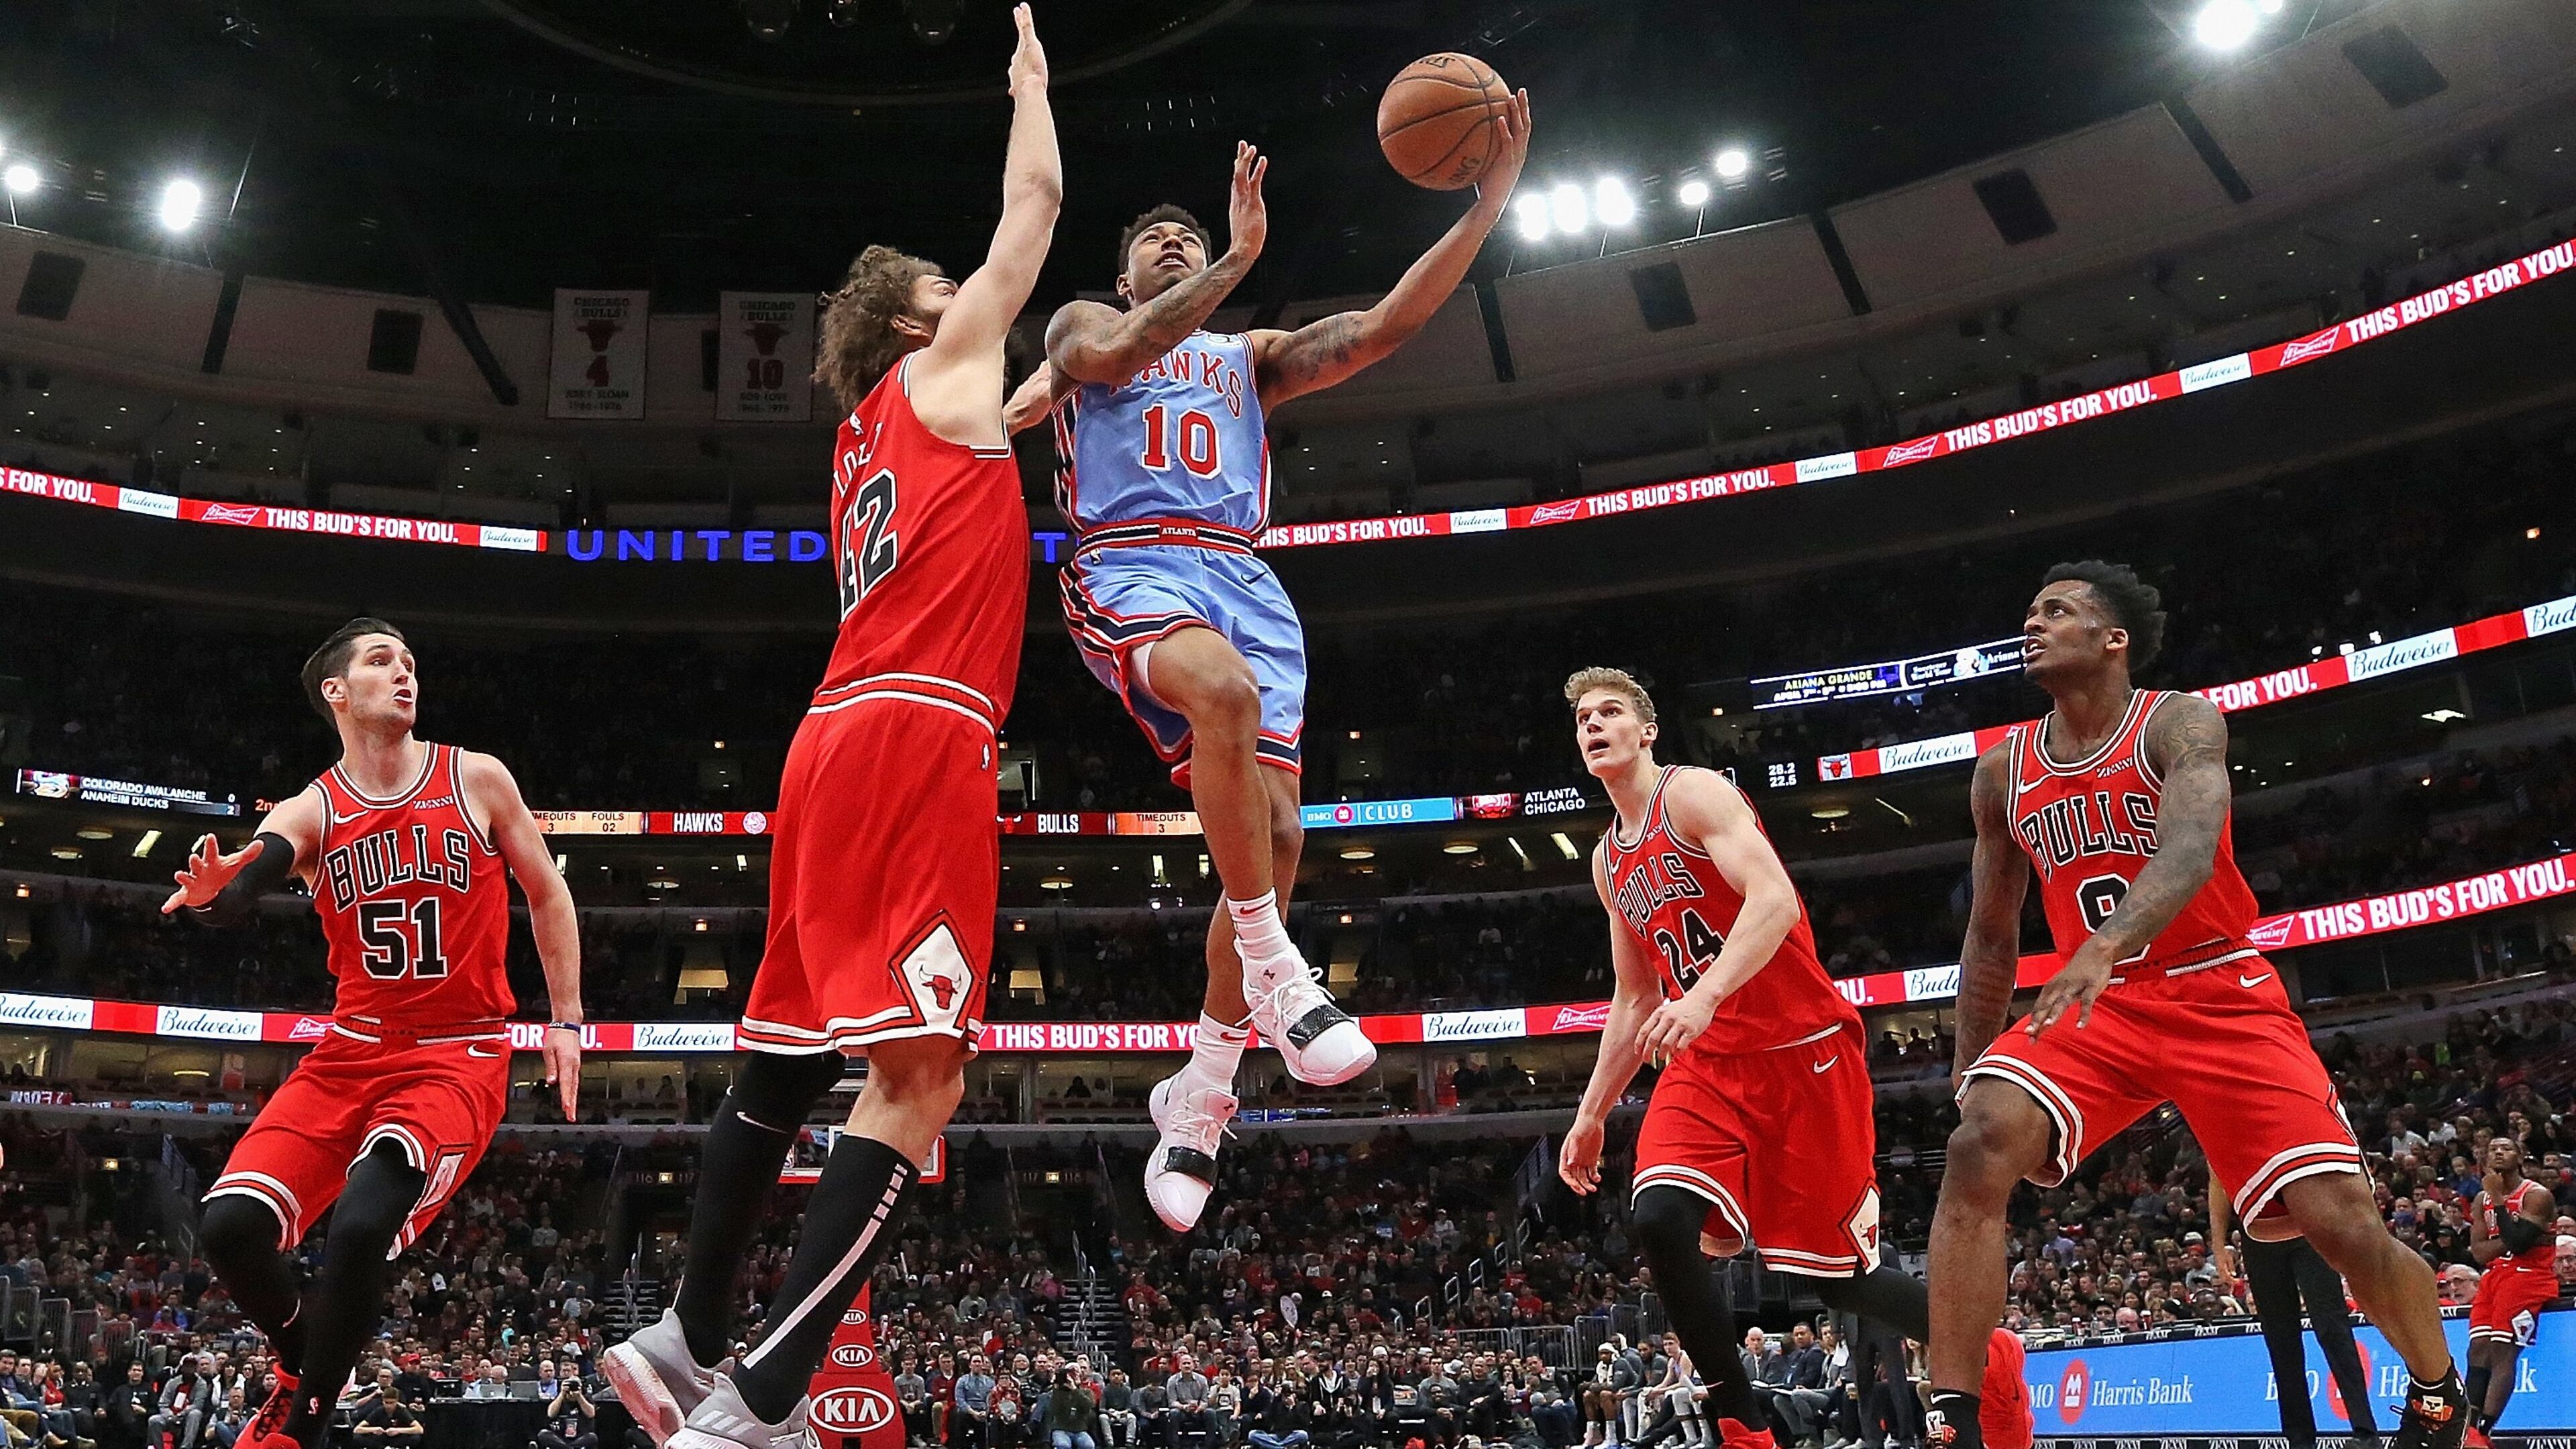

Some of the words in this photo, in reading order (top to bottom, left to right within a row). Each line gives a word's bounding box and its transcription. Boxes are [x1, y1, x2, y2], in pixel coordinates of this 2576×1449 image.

[2346, 314, 2398, 342] THIS
[2404, 280, 2471, 324] BUD'S
[2473, 263, 2521, 298] FOR
[2523, 242, 2576, 279] YOU.
[581, 307, 621, 319] BULLS
[747, 311, 788, 322] BULLS
[586, 355, 610, 388] 4
[740, 359, 784, 390] 10
[1112, 348, 1243, 419] AWKS
[2184, 359, 2245, 388] Budweiser
[1945, 423, 1991, 451] THIS
[1995, 405, 2057, 439] BUD'S
[2060, 394, 2102, 422] FOR
[2105, 381, 2157, 410] YOU.
[1142, 403, 1221, 480] 10
[1799, 459, 1854, 477] Budweiser
[9, 470, 48, 494] FOR
[52, 477, 96, 503] YOU.
[1586, 493, 1628, 516] THIS
[1631, 484, 1687, 508] BUD'S
[1691, 476, 1727, 499] FOR
[1731, 469, 1775, 492] YOU.
[121, 492, 175, 512] Budweiser
[266, 508, 309, 530] THIS
[314, 513, 371, 535] BUD'S
[375, 517, 411, 539] FOR
[416, 521, 458, 543] YOU.
[1162, 527, 1197, 537] ATLANTA
[1252, 527, 1289, 547] HIS
[1293, 523, 1346, 544] BUD'S
[1350, 521, 1385, 540] FOR
[1388, 517, 1430, 537] YOU.
[1453, 515, 1503, 529] Budweiser
[483, 529, 534, 545] Budweiser
[566, 530, 826, 562] UNITED
[840, 468, 898, 623] 42
[2353, 639, 2451, 677] Budweiser
[1784, 676, 1825, 690] ARIANA
[1828, 670, 1872, 685] GRANDE
[2210, 681, 2258, 710] FOR
[2261, 667, 2317, 700] YOU.
[1884, 742, 1971, 770] Budweiser
[80, 790, 129, 806] ANAHEIM
[131, 794, 170, 810] DUCKS
[82, 777, 143, 794] COLORADO
[144, 784, 207, 801] AVALANCHE
[227, 794, 235, 803] 0
[1524, 787, 1578, 804] ATLANTA
[227, 805, 235, 815] 2
[591, 812, 625, 821] FOULS
[1136, 812, 1186, 822] TIMEOUTS
[1307, 812, 1332, 822] BMO
[1364, 803, 1413, 821] CLUB
[1524, 796, 1585, 815] CHICAGO
[547, 823, 555, 833] 3
[602, 823, 616, 833] 02
[674, 812, 723, 833] HAWKS
[1037, 814, 1079, 833] BULLS
[1158, 824, 1165, 833] 3
[2018, 791, 2159, 884] BULLS
[325, 824, 470, 914] BULLS
[1617, 852, 1705, 941] BULLS
[2299, 903, 2365, 940] THIS
[2369, 886, 2454, 928] BUD'S
[2455, 873, 2509, 912] FOR
[2510, 859, 2575, 899] YOU.
[356, 896, 448, 979] 51
[1653, 906, 1727, 997] 24
[162, 1008, 257, 1034] Budweiser
[1429, 1016, 1521, 1038] Budweiser
[504, 1024, 544, 1049] FOR
[637, 1025, 730, 1046] Budweiser
[992, 1024, 1045, 1049] THIS
[1051, 1024, 1121, 1049] BUD'S
[1125, 1024, 1169, 1049] FOR
[843, 1313, 863, 1322] KIA
[839, 1349, 866, 1362] KIA
[2031, 1383, 2055, 1409] MO
[2091, 1379, 2145, 1407] Harris
[2147, 1374, 2194, 1405] Bank
[823, 1397, 880, 1423] KIA
